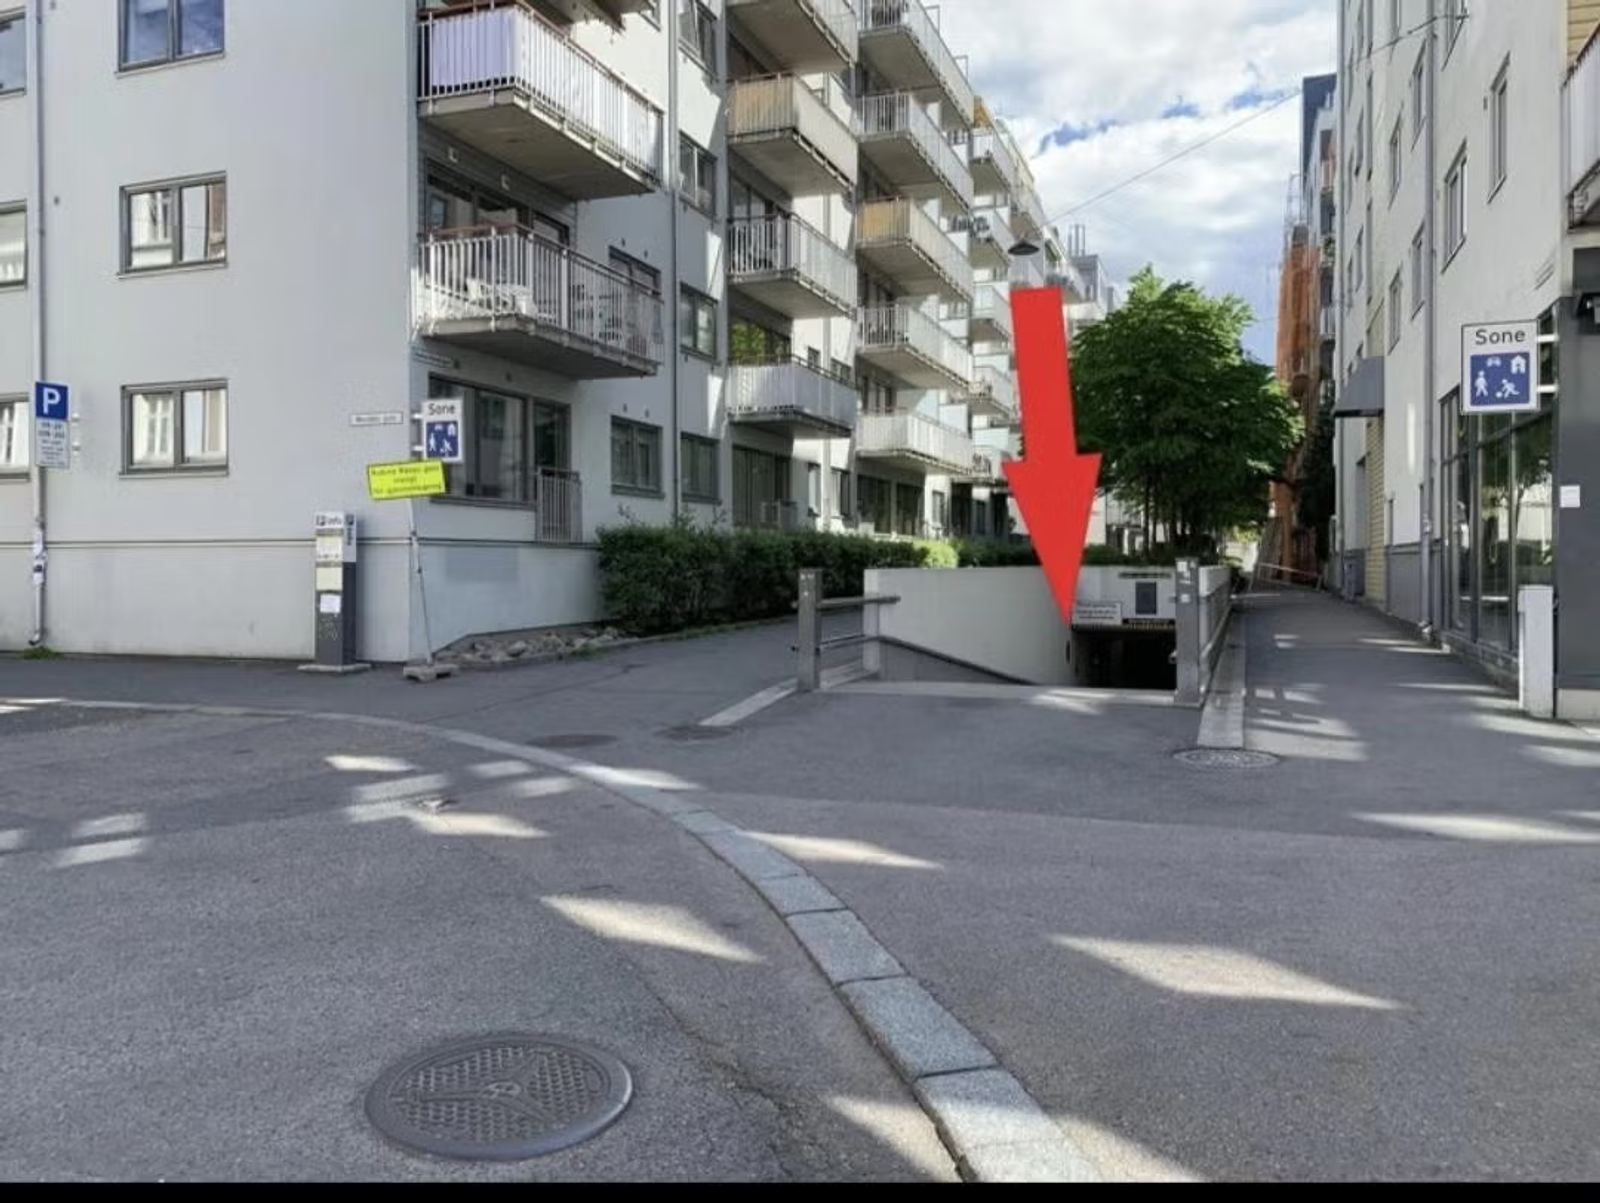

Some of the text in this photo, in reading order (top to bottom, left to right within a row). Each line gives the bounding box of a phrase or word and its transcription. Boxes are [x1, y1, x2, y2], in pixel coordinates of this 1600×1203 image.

[1475, 328, 1526, 345] Sone
[43, 387, 60, 414] P
[428, 403, 456, 415] Sone
